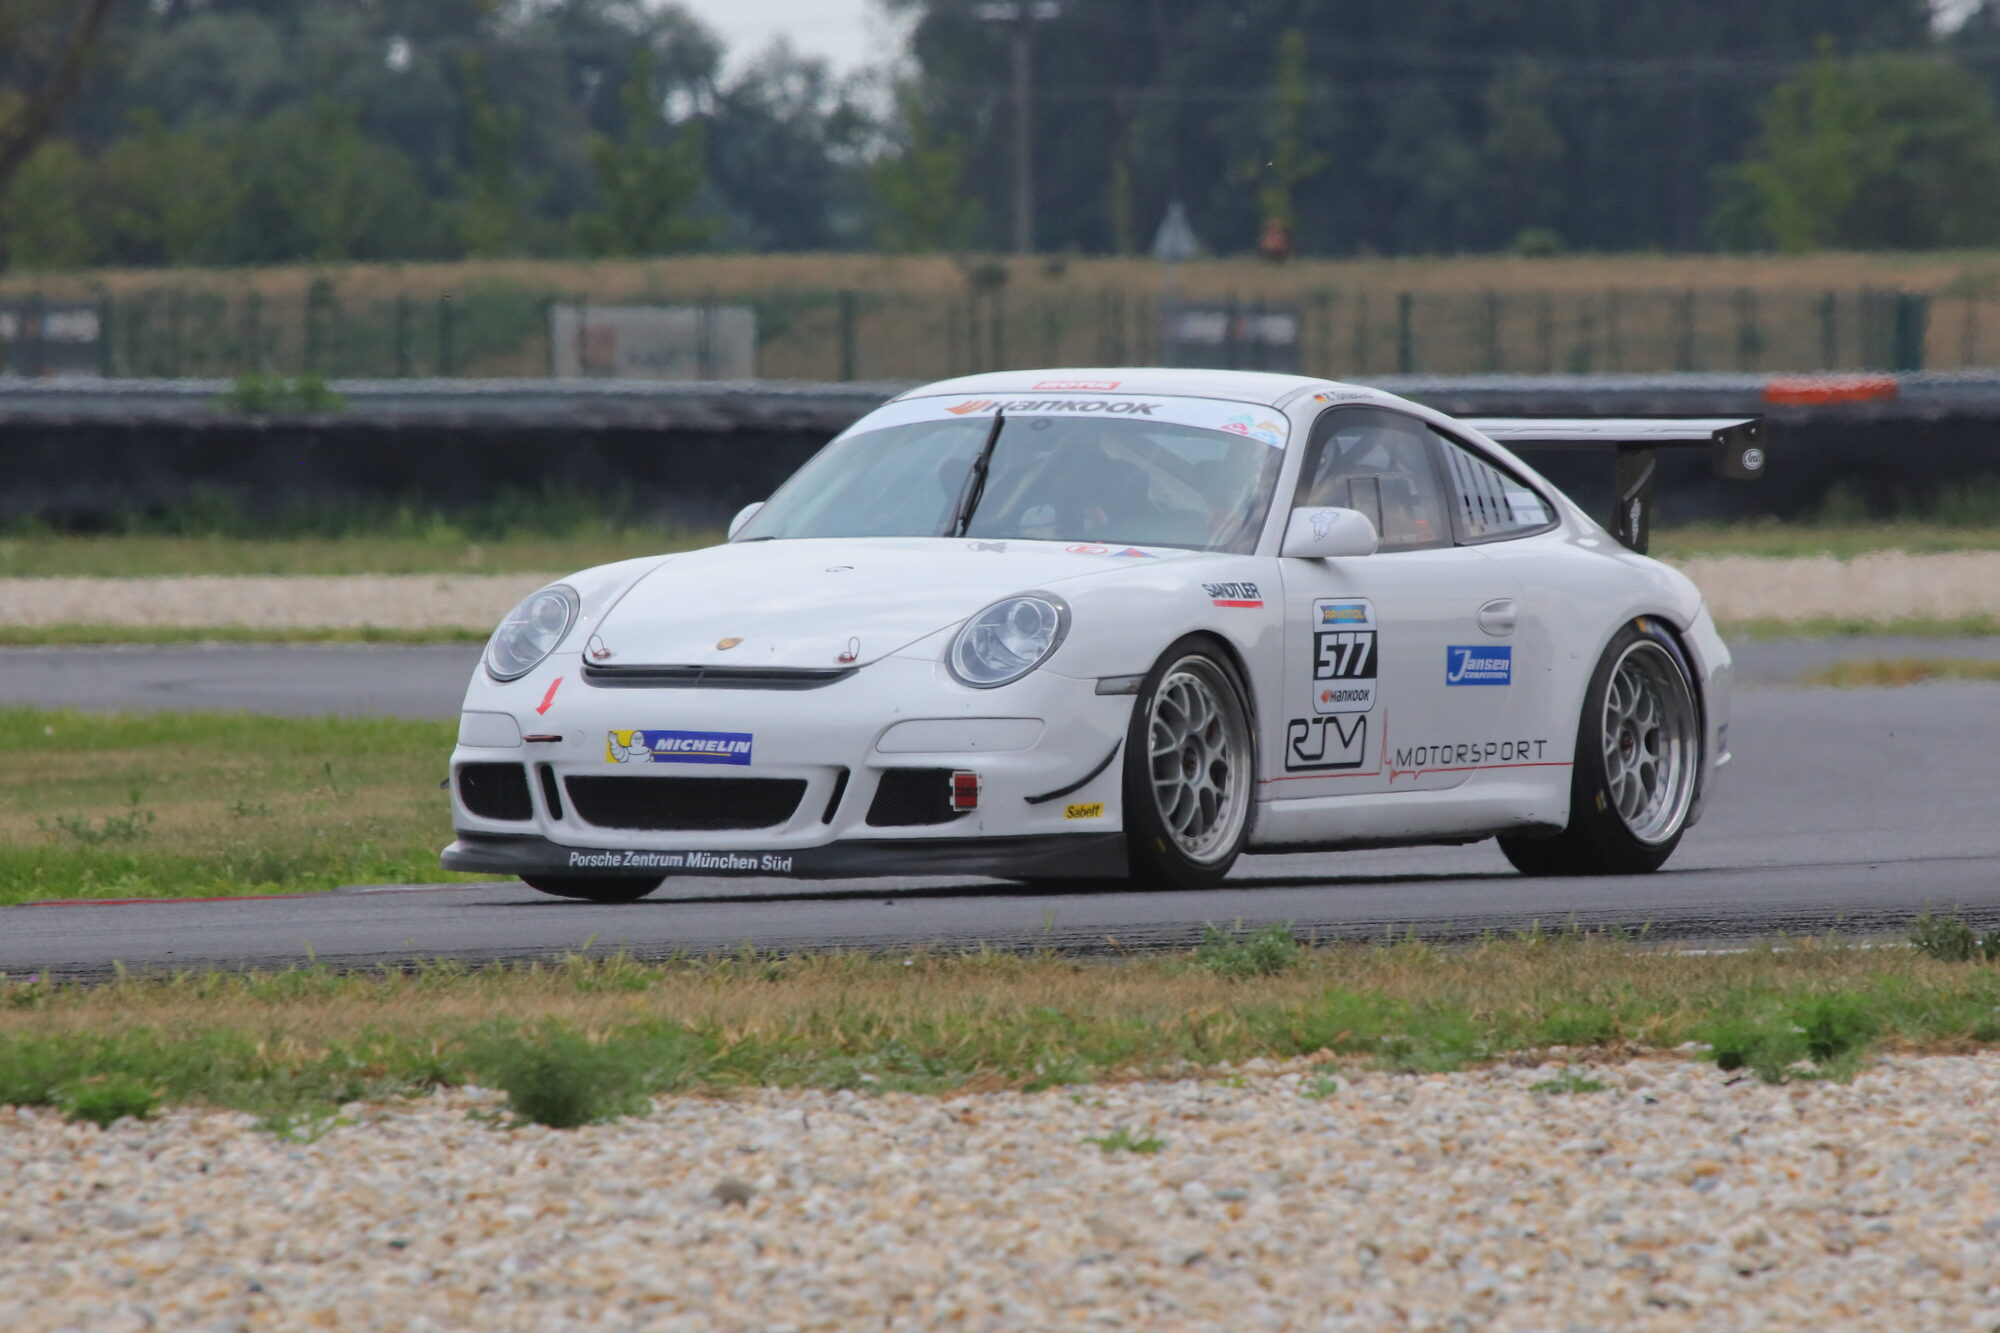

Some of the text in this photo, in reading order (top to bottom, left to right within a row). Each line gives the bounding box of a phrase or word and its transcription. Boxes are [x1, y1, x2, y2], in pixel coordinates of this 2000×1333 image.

[1201, 582, 1262, 599] SANDTLER
[1317, 632, 1373, 678] 577
[1448, 649, 1509, 682] Jansen
[655, 738, 751, 753] MICHELIN
[1396, 740, 1548, 767] MOTORSPORT
[569, 851, 793, 873] Porsche Zentrum München Süd
